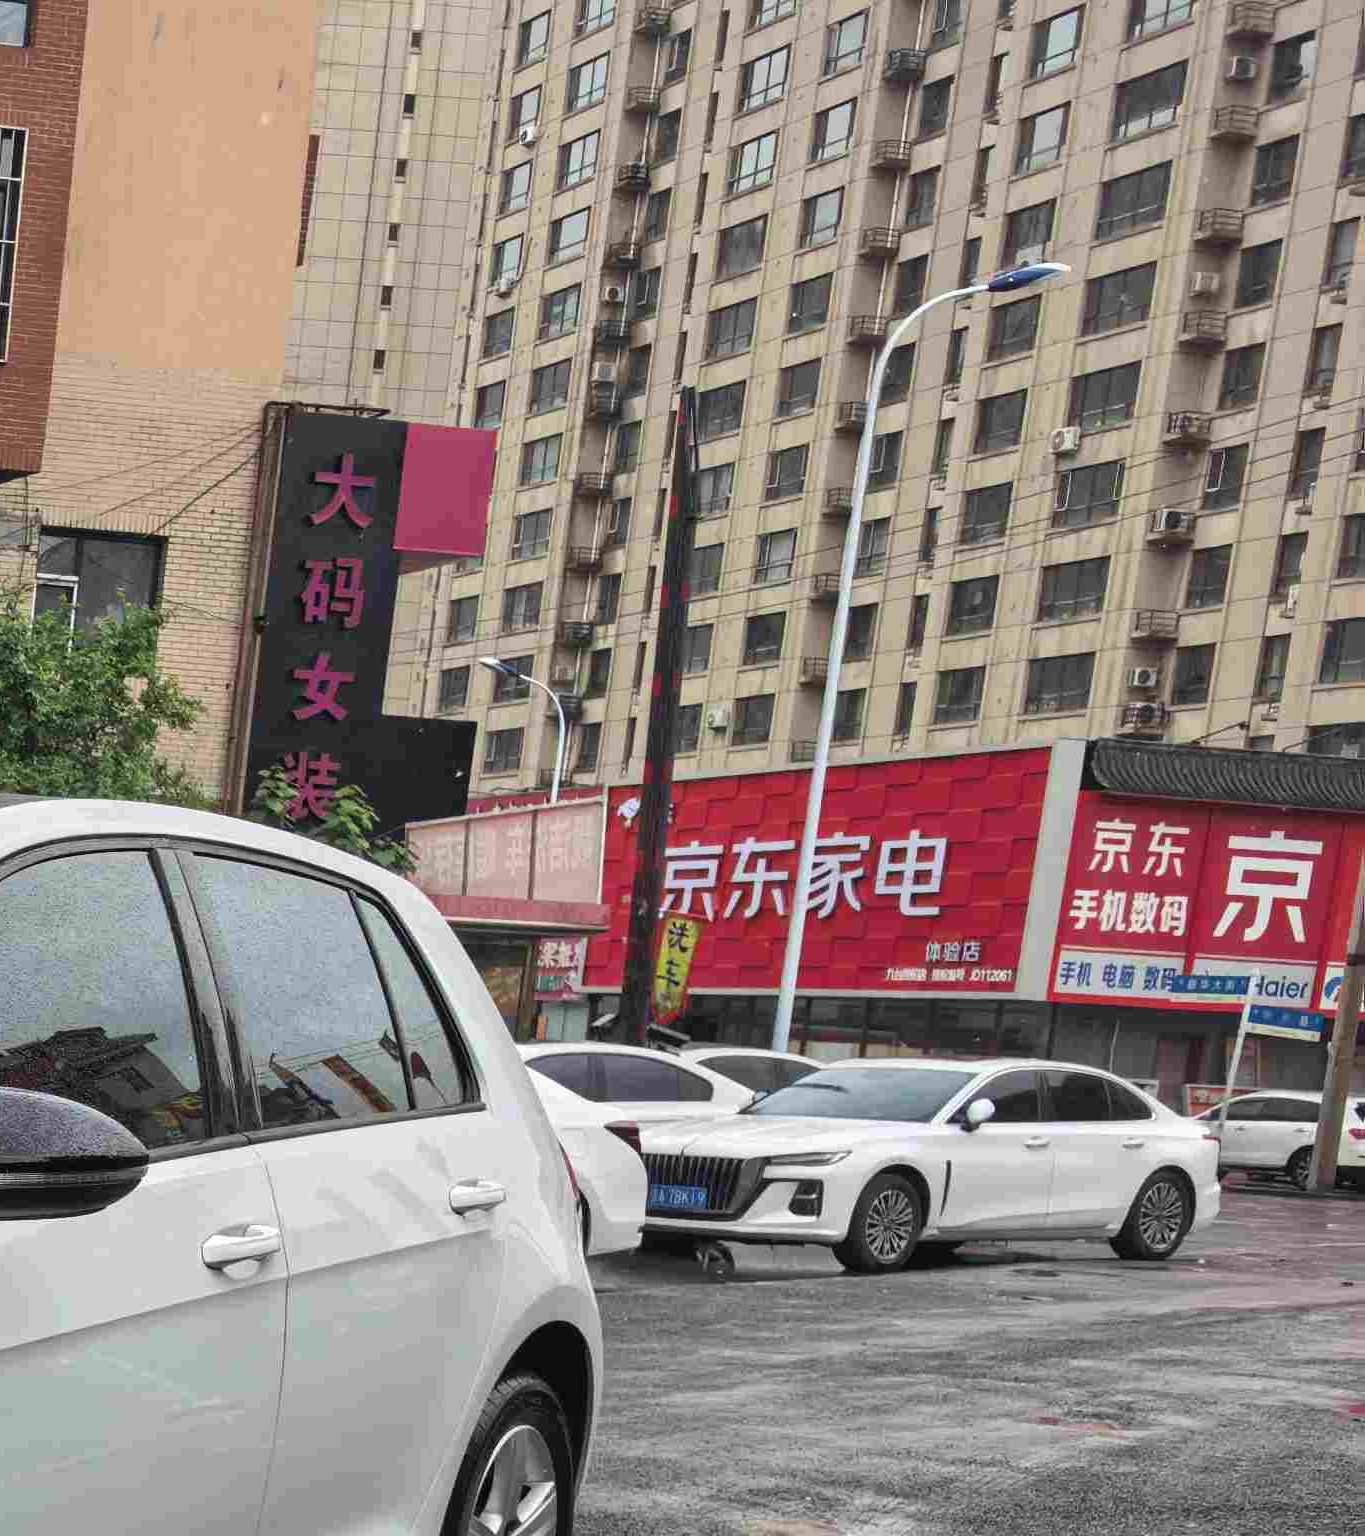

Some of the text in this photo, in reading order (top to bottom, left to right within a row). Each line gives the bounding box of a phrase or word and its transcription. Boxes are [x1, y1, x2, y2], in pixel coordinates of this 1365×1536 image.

[280, 450, 375, 820] 大码女装
[658, 829, 949, 923] 京东家电
[1089, 818, 1190, 877] 京东
[1069, 888, 1189, 937] 手机数码
[1212, 831, 1323, 943] 京
[1060, 961, 1176, 993] 手机 电脑 数码
